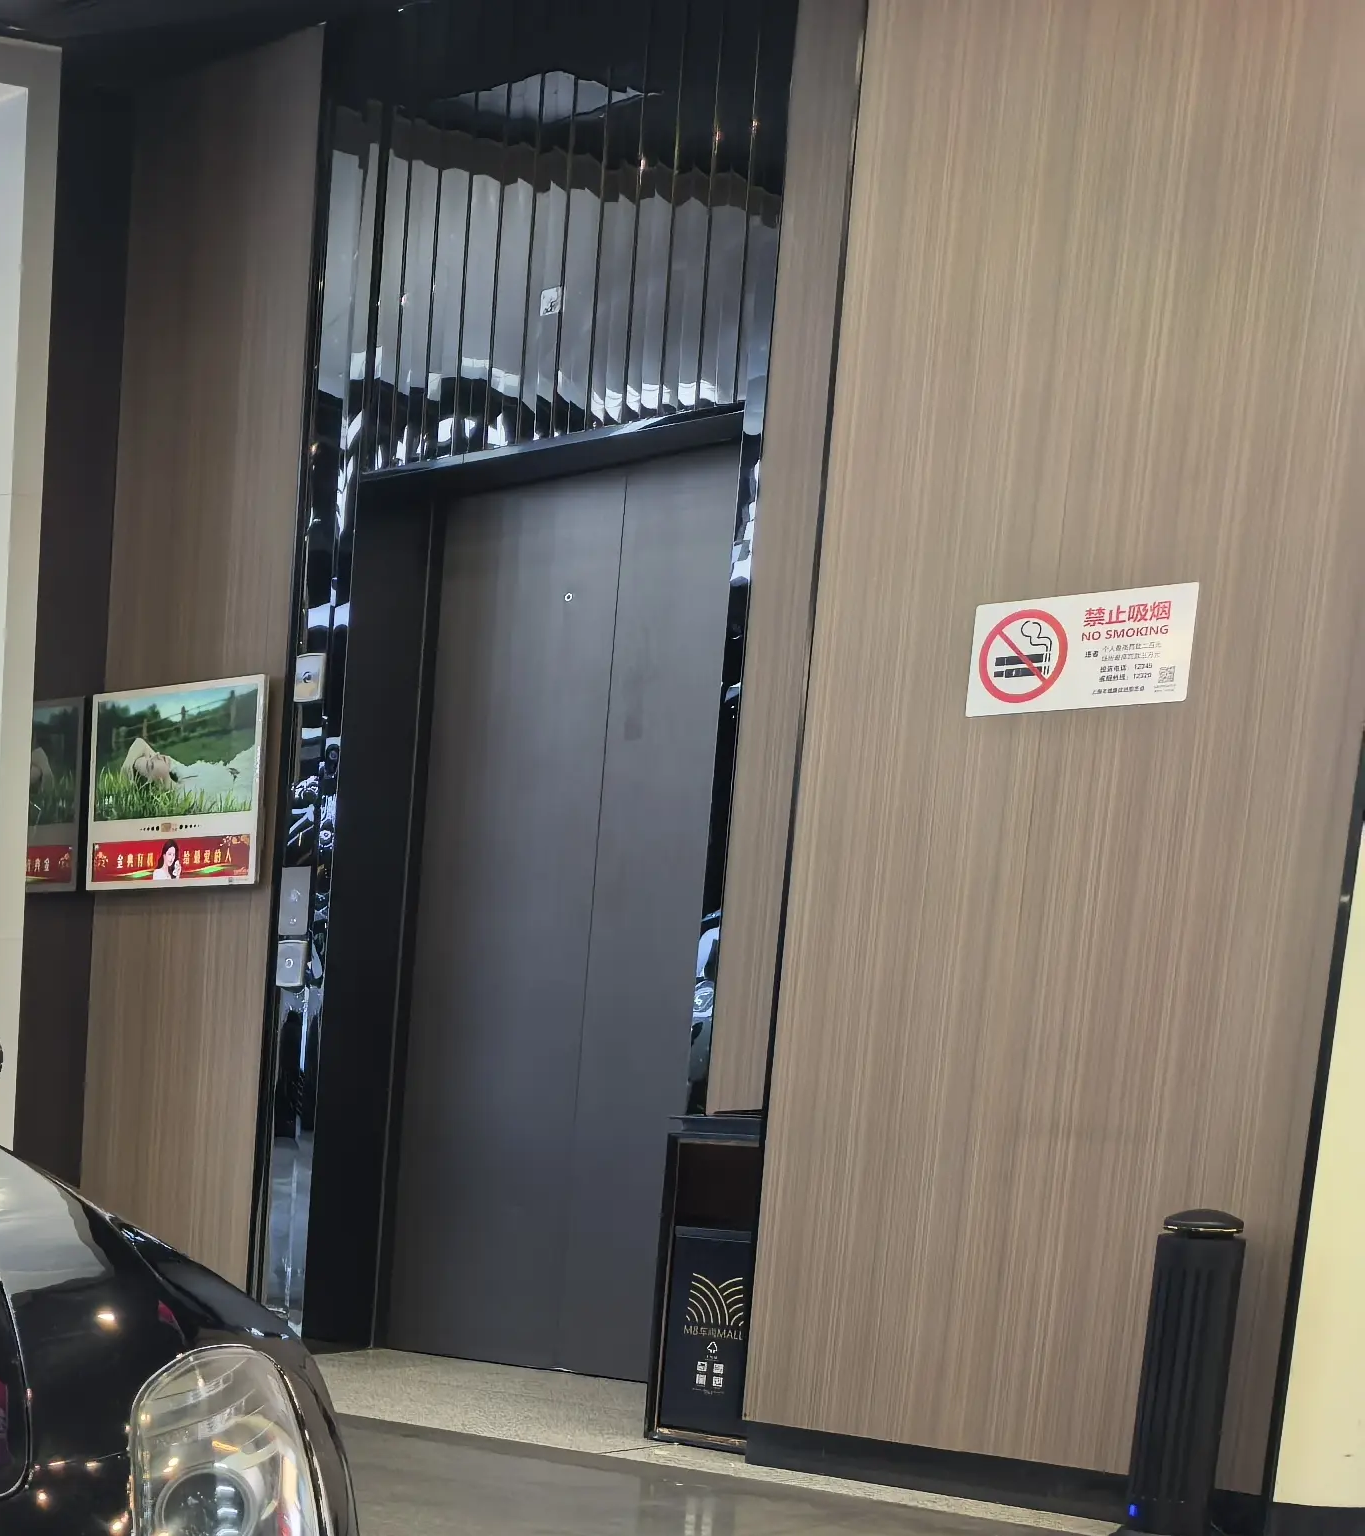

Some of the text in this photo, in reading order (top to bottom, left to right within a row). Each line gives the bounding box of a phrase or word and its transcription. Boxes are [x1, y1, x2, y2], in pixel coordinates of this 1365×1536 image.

[1083, 600, 1172, 627] 禁止吸烟
[1081, 624, 1169, 642] NO SMOKING
